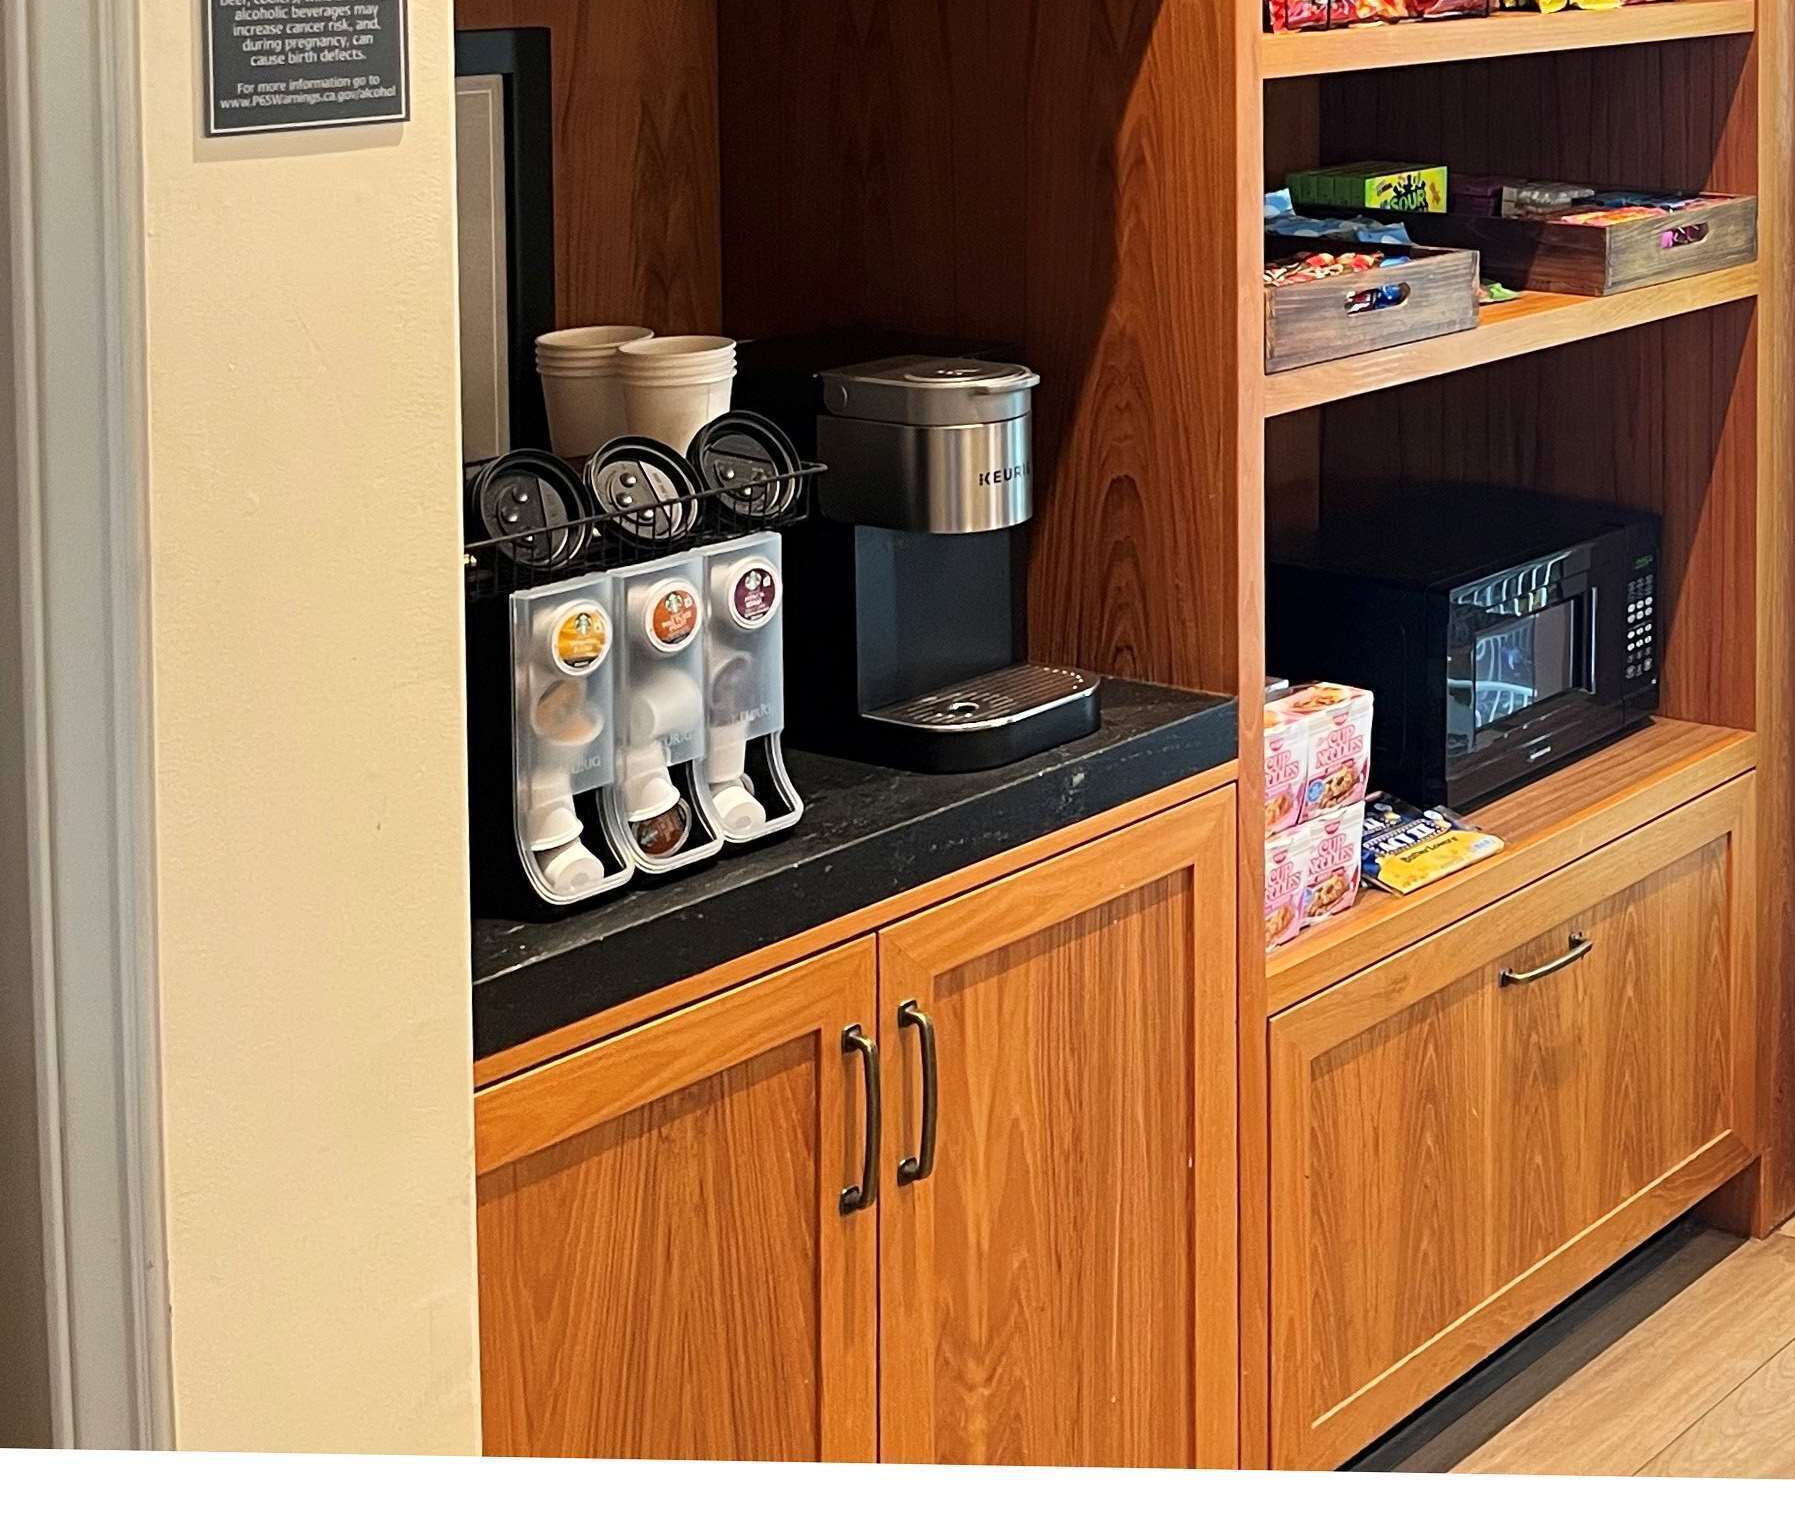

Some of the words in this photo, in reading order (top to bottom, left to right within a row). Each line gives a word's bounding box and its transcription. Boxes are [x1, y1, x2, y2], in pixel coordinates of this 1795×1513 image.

[234, 7, 289, 21] alcoholic
[291, 5, 351, 21] beverages
[354, 5, 379, 19] may
[233, 23, 283, 36] increase
[286, 21, 326, 34] cancer
[329, 18, 353, 32] risk,
[242, 39, 282, 53] during
[284, 36, 350, 52] pregnancy,
[352, 34, 374, 45] can
[250, 54, 285, 66] cause
[287, 51, 318, 64] birth
[319, 48, 367, 63] defects.
[237, 82, 255, 94] For
[257, 81, 287, 92] more
[288, 75, 351, 91] information
[352, 76, 367, 89] go
[368, 75, 381, 86] to
[1390, 189, 1427, 211] SOUR
[979, 461, 1031, 486] KEURI
[1328, 724, 1356, 749] CUP
[1318, 833, 1347, 857] CUP
[1268, 861, 1295, 888] CUP
